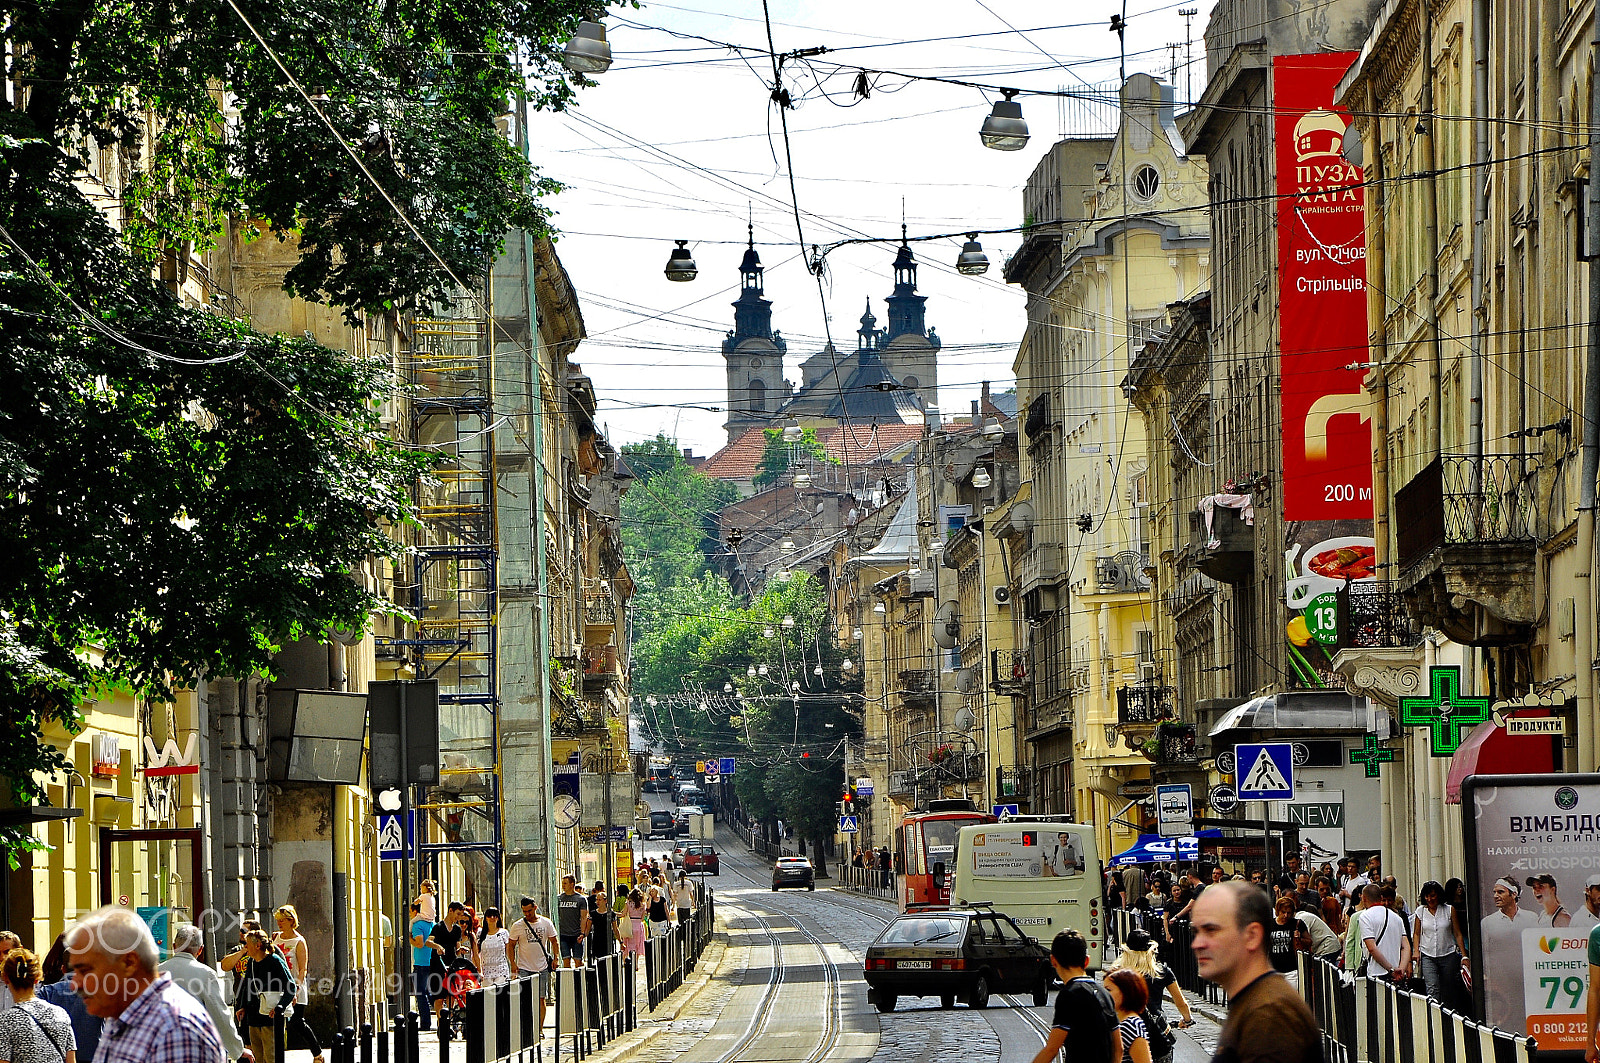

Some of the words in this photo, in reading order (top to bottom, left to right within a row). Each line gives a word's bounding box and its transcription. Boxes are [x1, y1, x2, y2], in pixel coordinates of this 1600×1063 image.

[1295, 164, 1360, 183] ПУЗА
[1298, 184, 1357, 203] ХАТА
[1298, 206, 1343, 214] КРАЇНСЬКІ
[1296, 249, 1324, 264] вул.
[1329, 246, 1366, 260] Січов
[1296, 274, 1367, 294] Стрільців,
[1324, 484, 1354, 501] 200
[1316, 595, 1337, 604] Бор
[1314, 608, 1336, 630] 13
[1510, 720, 1562, 732] ПРОДУКТИ
[1290, 806, 1340, 826] NEW
[1487, 846, 1538, 855] НАЖИВО
[1535, 961, 1588, 970] ІНТЕРНЕТ+
[1540, 976, 1583, 1009] 79
[1533, 1024, 1540, 1034] 0
[1544, 1023, 1565, 1034] 800
[1569, 1022, 1588, 1033] 212
